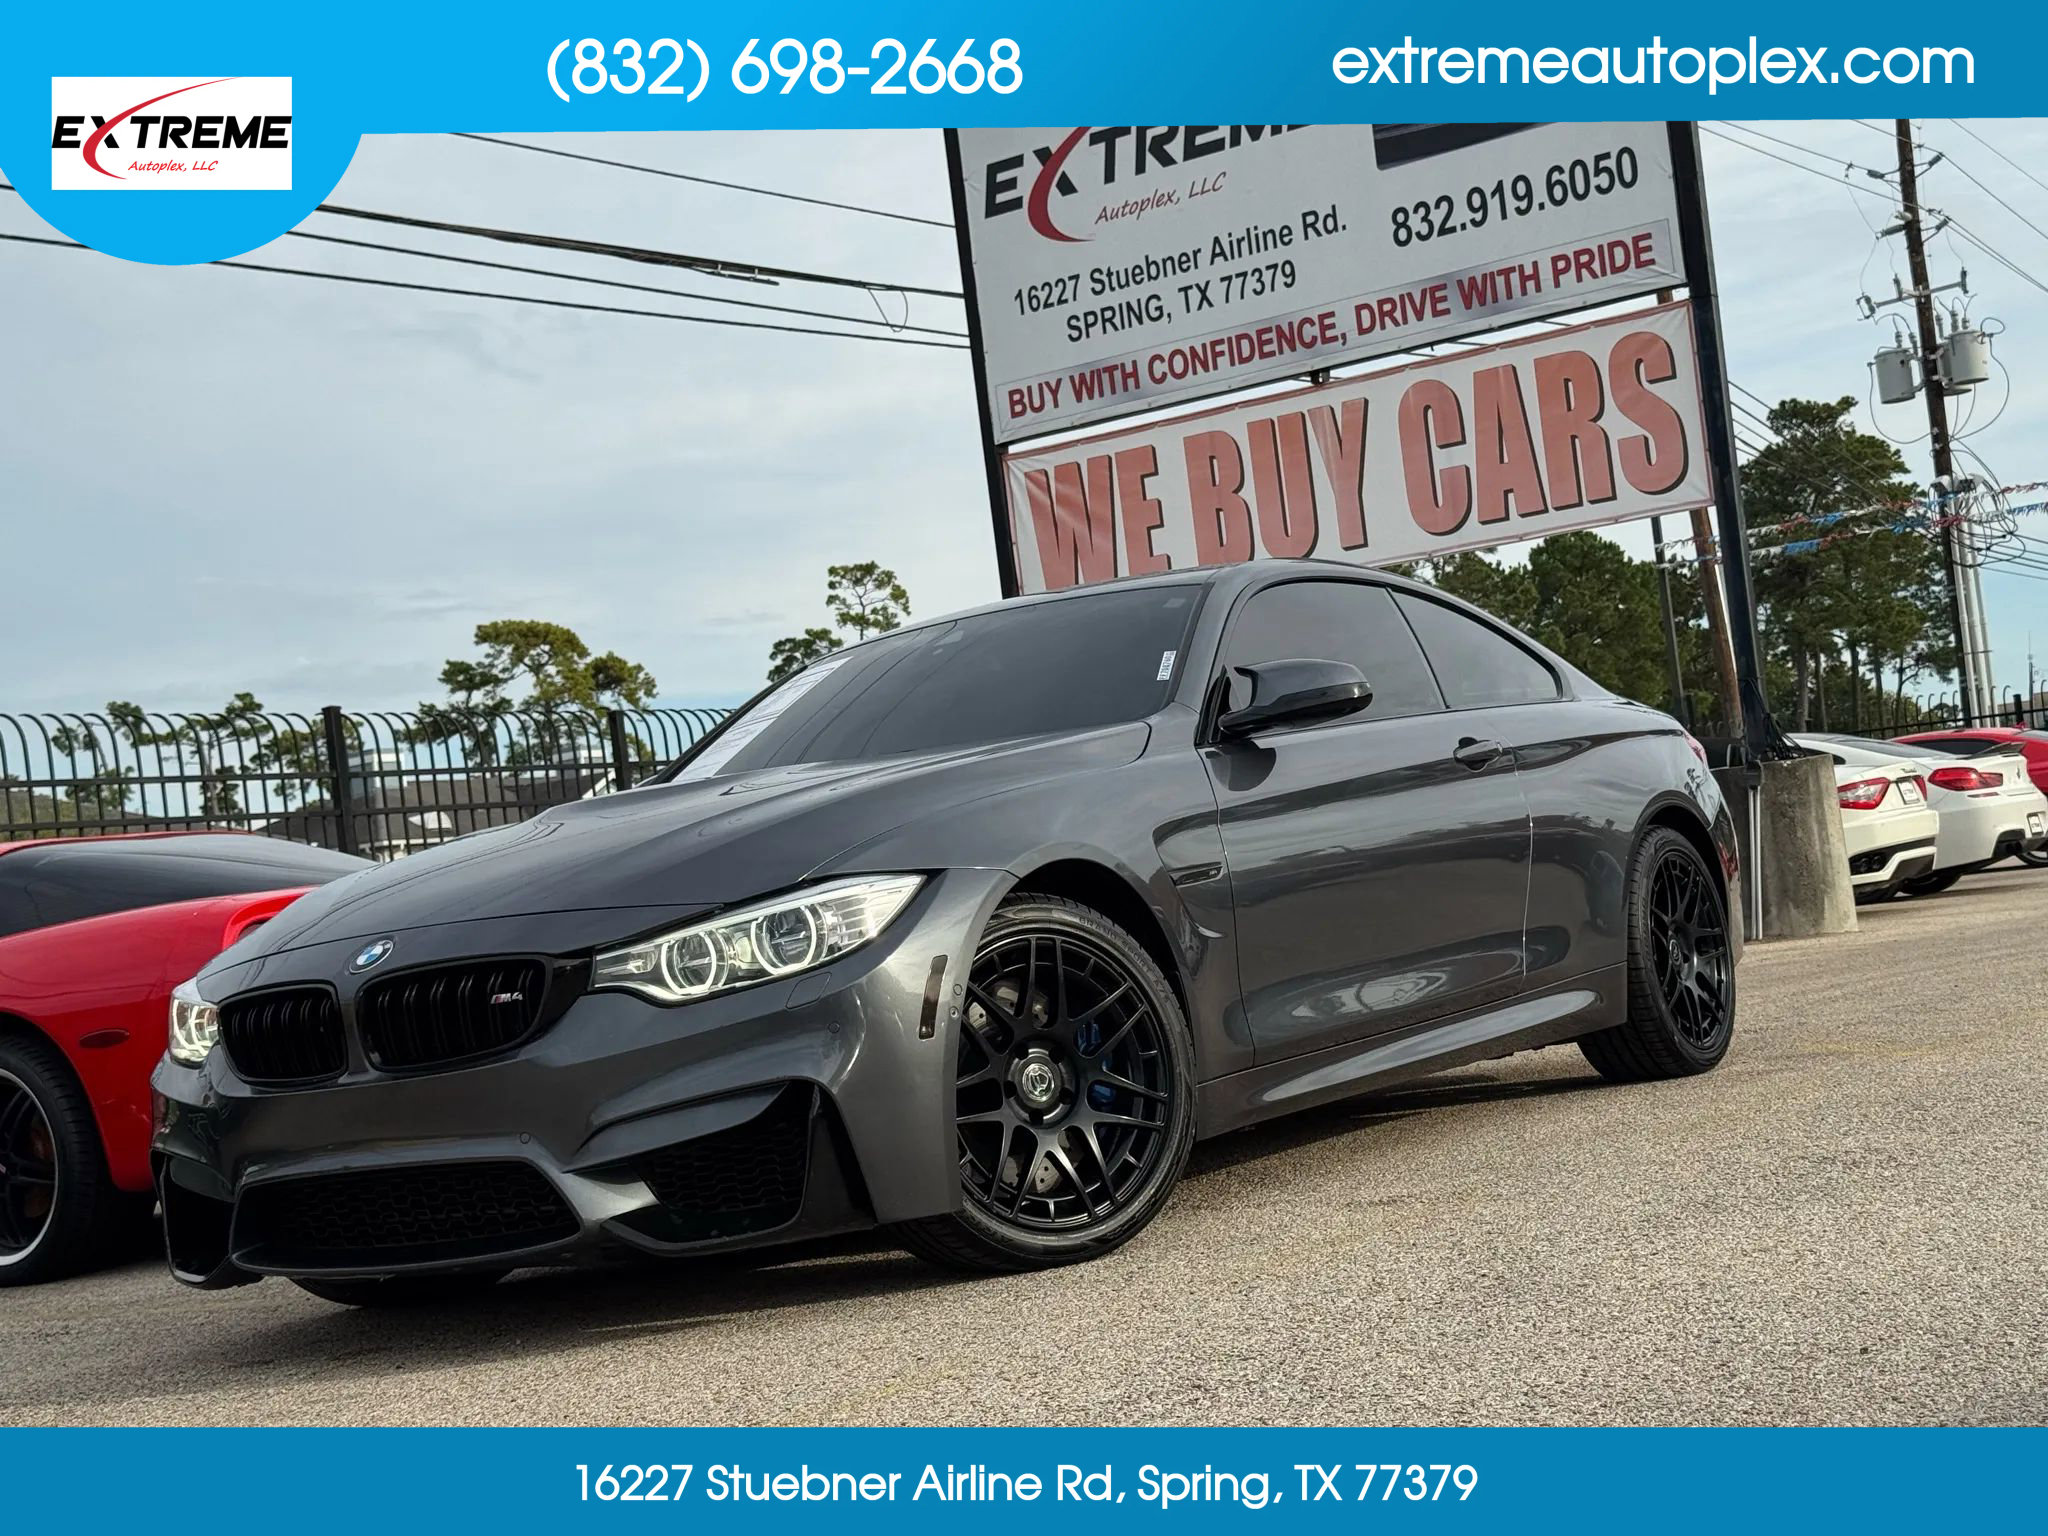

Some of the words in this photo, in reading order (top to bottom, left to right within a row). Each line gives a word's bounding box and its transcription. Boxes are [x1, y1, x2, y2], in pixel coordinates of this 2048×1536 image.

[1094, 188, 1181, 225] Autoplex,
[1187, 170, 1227, 200] LLC
[1391, 146, 1639, 248] 832.919.6050
[1014, 274, 1081, 316] 16227
[1089, 247, 1202, 296] Stuebner
[1208, 223, 1294, 267] Airline
[1301, 204, 1347, 241] Rd.
[1066, 294, 1173, 343] SPRING,
[1177, 279, 1215, 315] TX
[1219, 259, 1297, 305] 77379
[1007, 377, 1063, 420] BUY
[1069, 359, 1141, 405] WITH
[1147, 311, 1347, 386] CONFIDENCE,
[1354, 283, 1451, 337] DRIVE
[1456, 260, 1542, 311] WITH
[1550, 232, 1657, 289] PRIDE
[1024, 444, 1172, 591] WE
[1183, 397, 1369, 567] BUY
[1398, 331, 1689, 537] CARS
